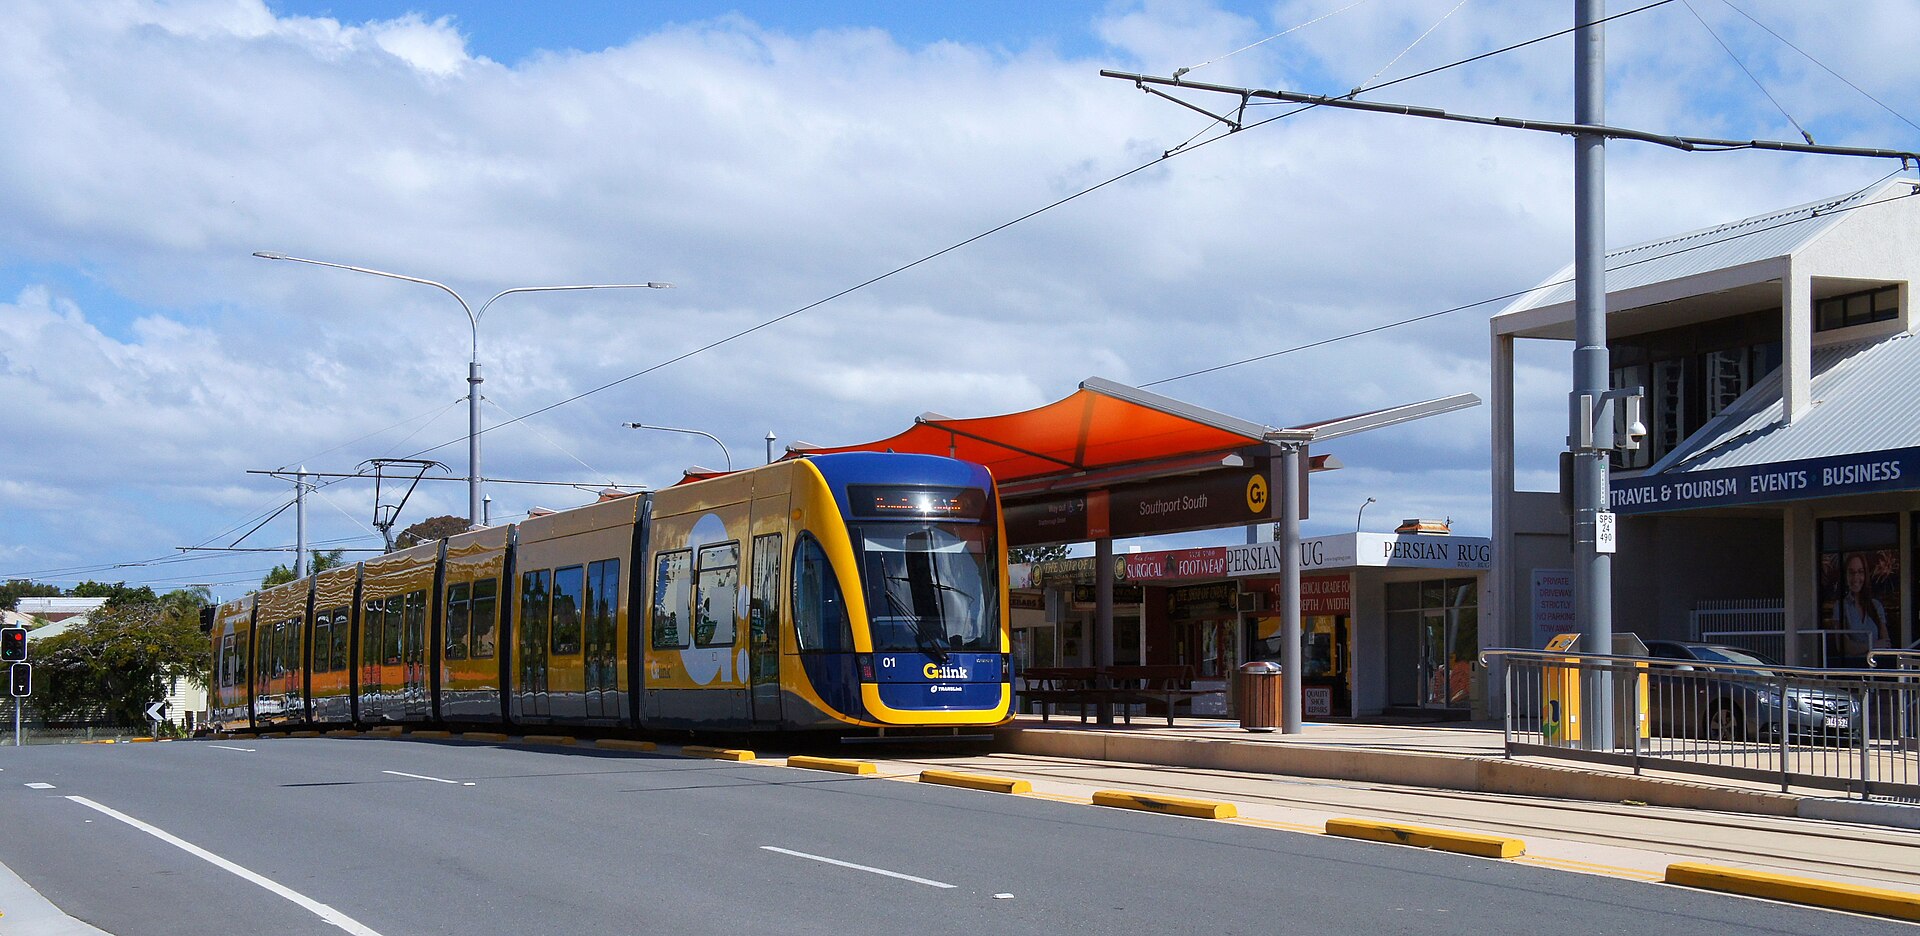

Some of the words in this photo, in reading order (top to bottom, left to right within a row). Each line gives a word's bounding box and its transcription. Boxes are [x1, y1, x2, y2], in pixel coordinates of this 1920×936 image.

[1610, 487, 1657, 507] TRAVEL
[1661, 485, 1672, 502] &
[1675, 478, 1737, 500] TOURISM
[1750, 470, 1807, 493] EVENTS
[1823, 460, 1900, 486] BUSINESS
[1139, 496, 1181, 516] Southport
[1182, 494, 1208, 510] South
[1599, 514, 1613, 524] SPS
[1599, 533, 1613, 543] 490
[1300, 540, 1323, 566] UG
[1384, 541, 1449, 560] PERSIAN
[1457, 544, 1490, 562] RUG
[1126, 562, 1163, 579] SURGICAL
[1178, 558, 1224, 576] FOOTWEAR
[1322, 581, 1341, 594] GRADE
[1542, 577, 1569, 585] PRIVATE
[1539, 589, 1573, 597] DRIVEWAY
[1326, 597, 1350, 610] WIDTH
[1541, 600, 1571, 609] STRICTLY
[1547, 612, 1575, 621] PARKING
[882, 657, 896, 668] 01
[923, 662, 968, 679] G:link
